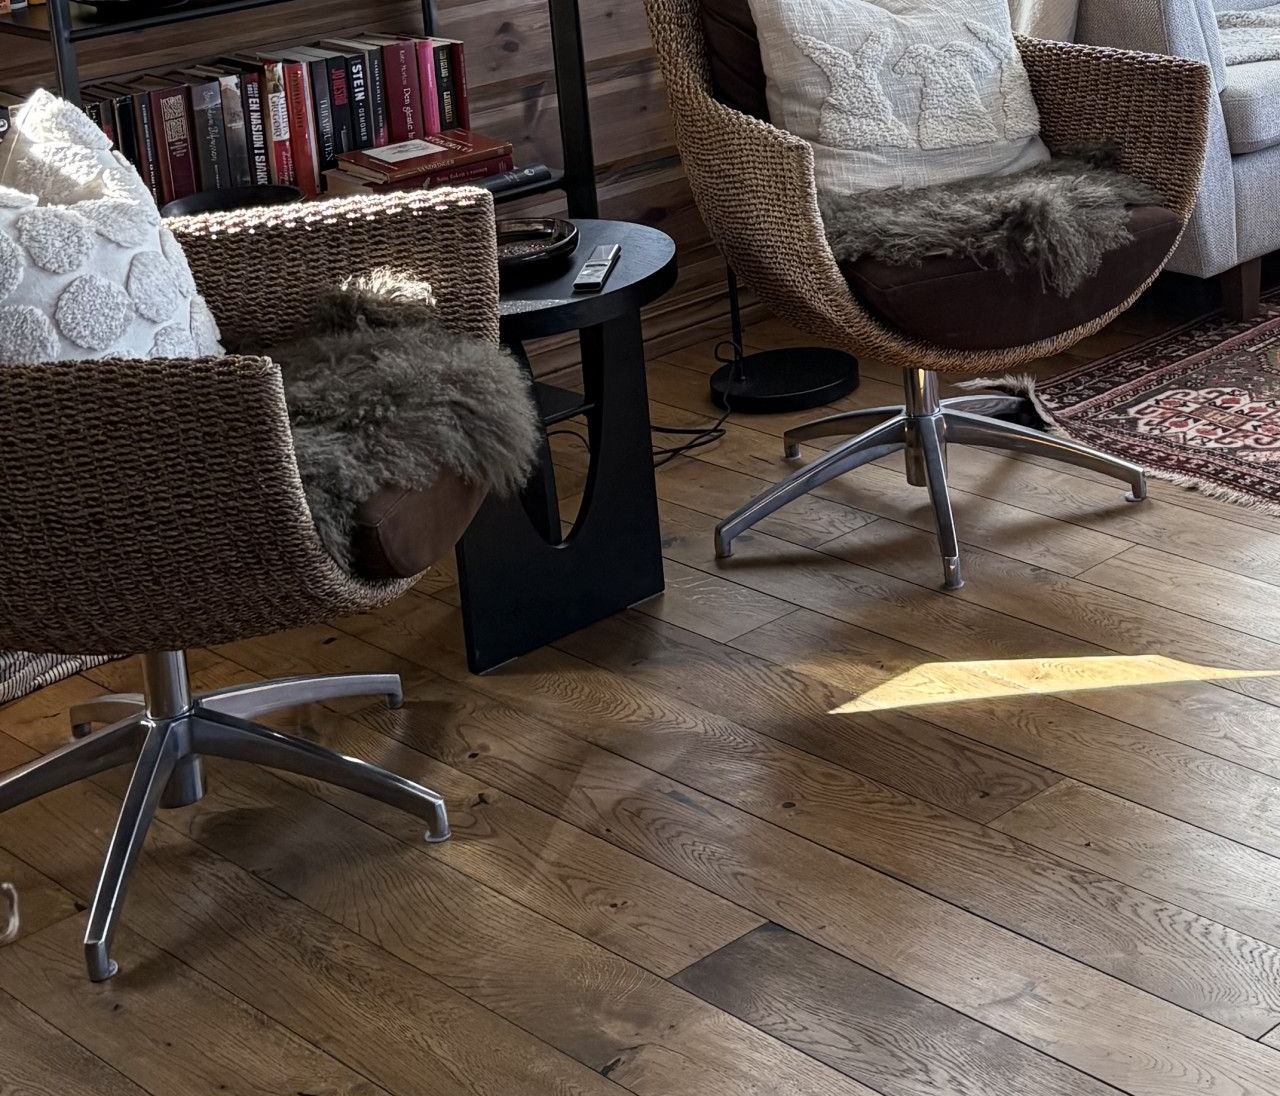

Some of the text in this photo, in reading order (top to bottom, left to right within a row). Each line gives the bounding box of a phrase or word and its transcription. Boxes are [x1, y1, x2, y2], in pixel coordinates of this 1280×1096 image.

[351, 64, 366, 101] STEIN
[403, 88, 411, 104] Den
[248, 98, 260, 110] EN
[270, 95, 282, 138] GREGORY
[250, 112, 264, 148] NASJON
[320, 99, 333, 161] TERAPEUTEN
[254, 155, 268, 186] SJAKK
